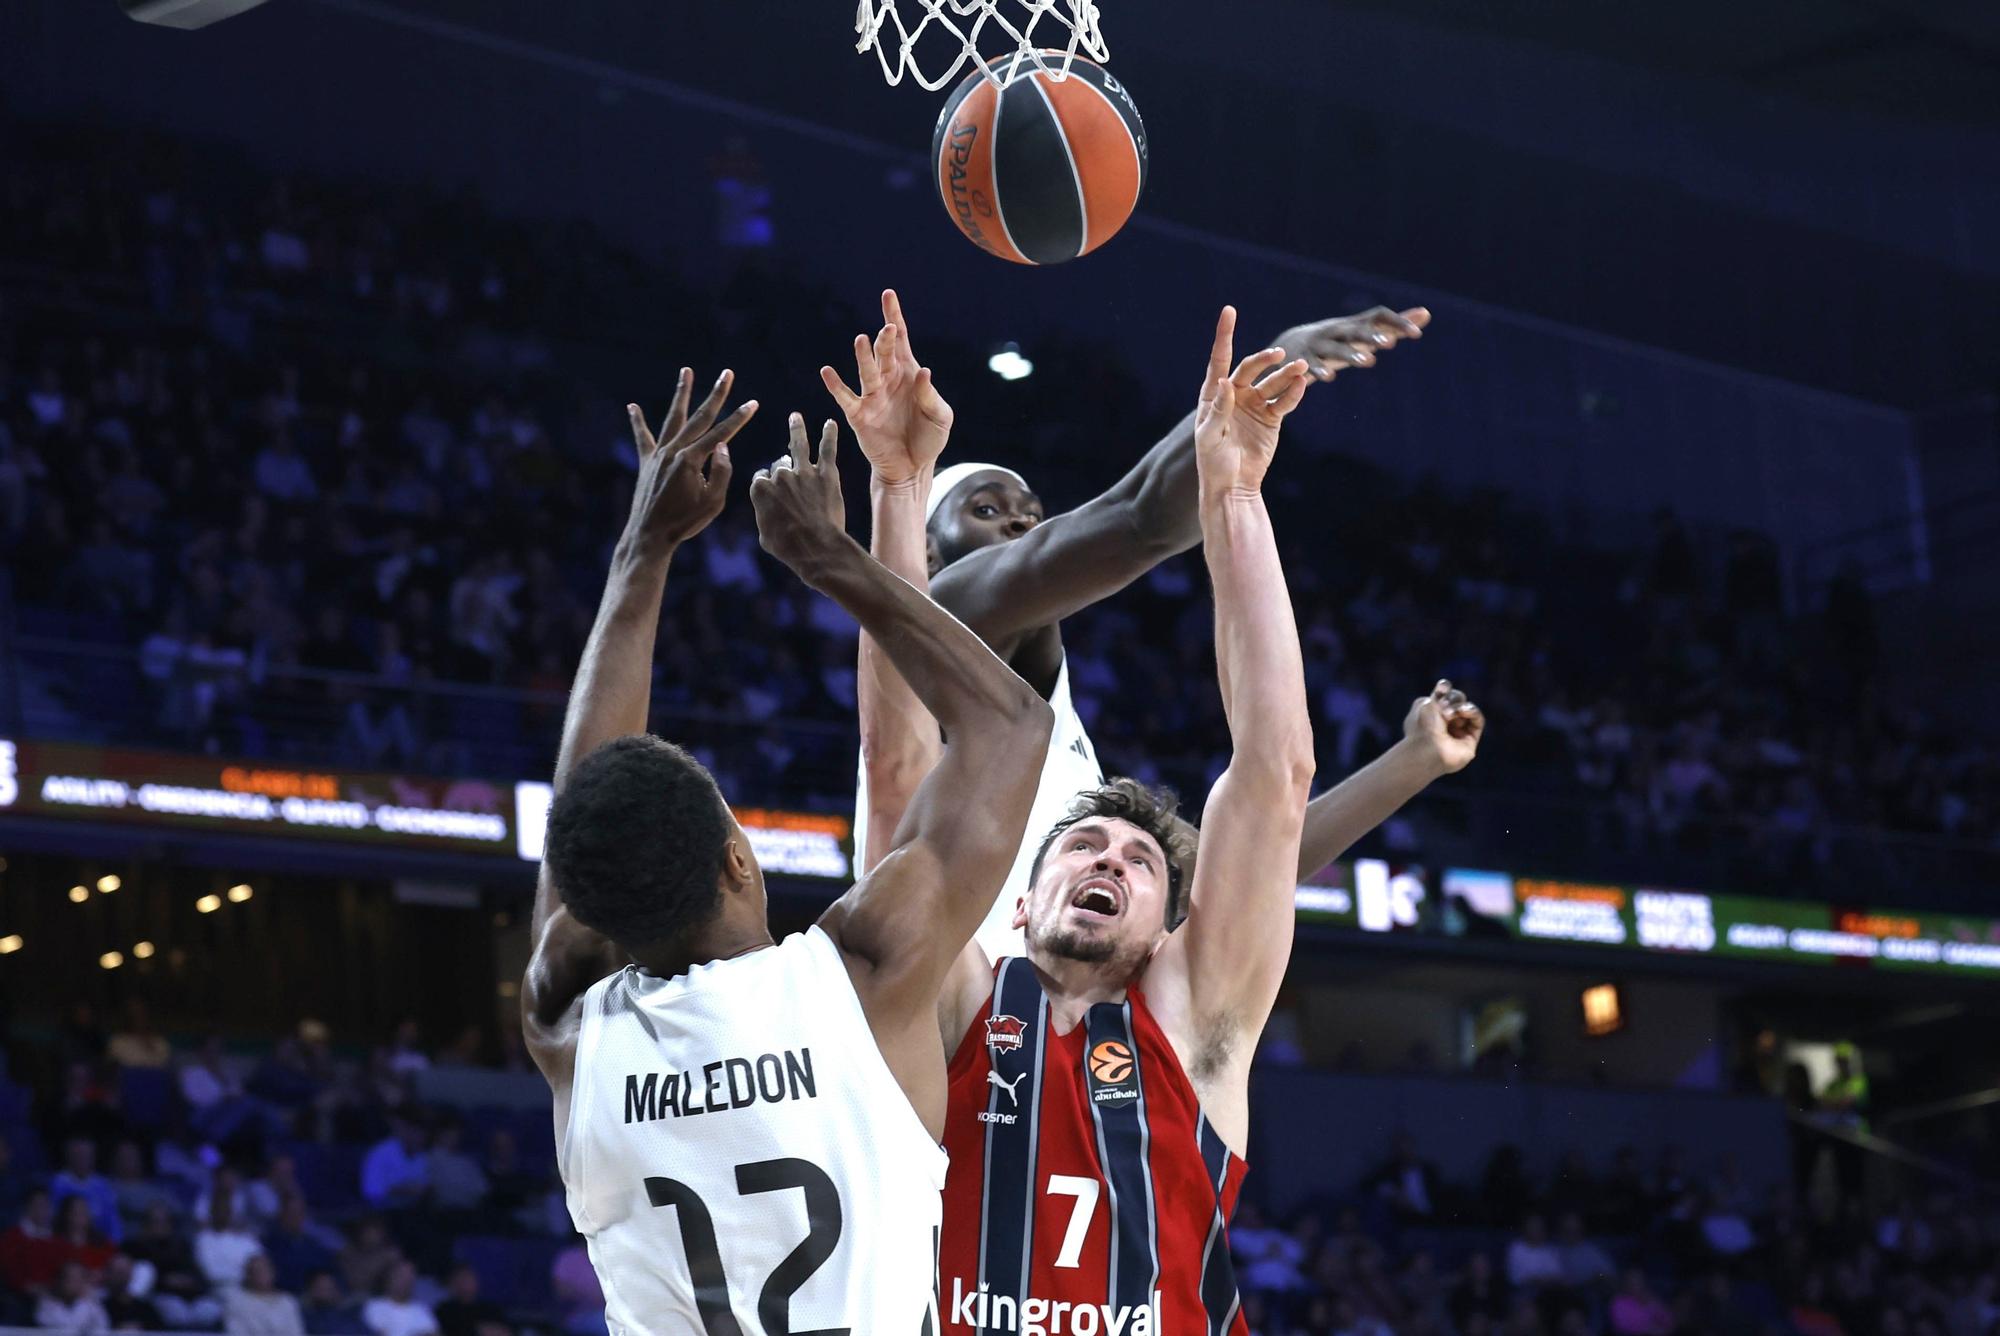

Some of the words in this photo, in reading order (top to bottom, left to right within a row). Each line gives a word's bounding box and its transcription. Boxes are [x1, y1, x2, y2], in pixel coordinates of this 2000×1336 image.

[624, 1047, 818, 1125] MALEDON
[1094, 1092, 1112, 1101] abu
[1112, 1089, 1138, 1099] dhabi
[643, 1157, 852, 1336] 12
[1046, 1174, 1101, 1269] 7
